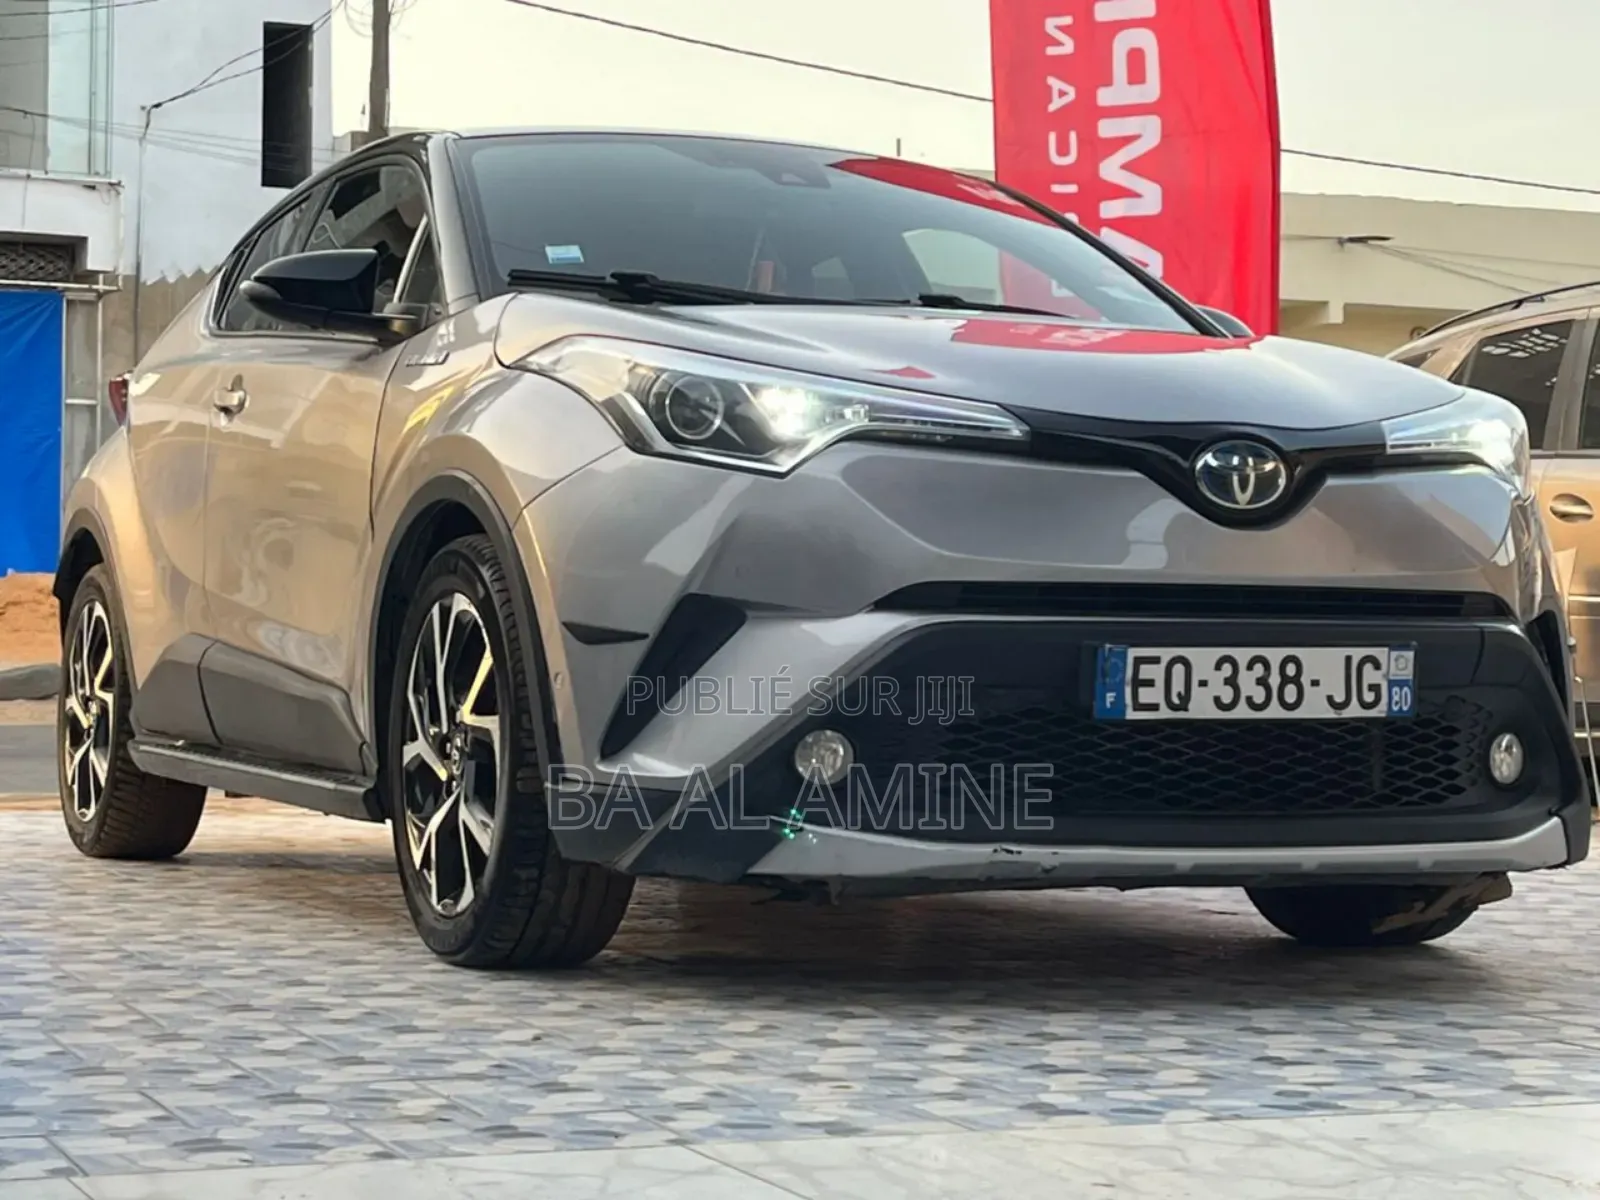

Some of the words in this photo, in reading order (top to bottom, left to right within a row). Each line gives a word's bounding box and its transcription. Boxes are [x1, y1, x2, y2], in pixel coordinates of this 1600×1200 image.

[1130, 655, 1382, 712] EQ-338-JG
[1105, 692, 1117, 708] F
[1391, 686, 1411, 711] 80
